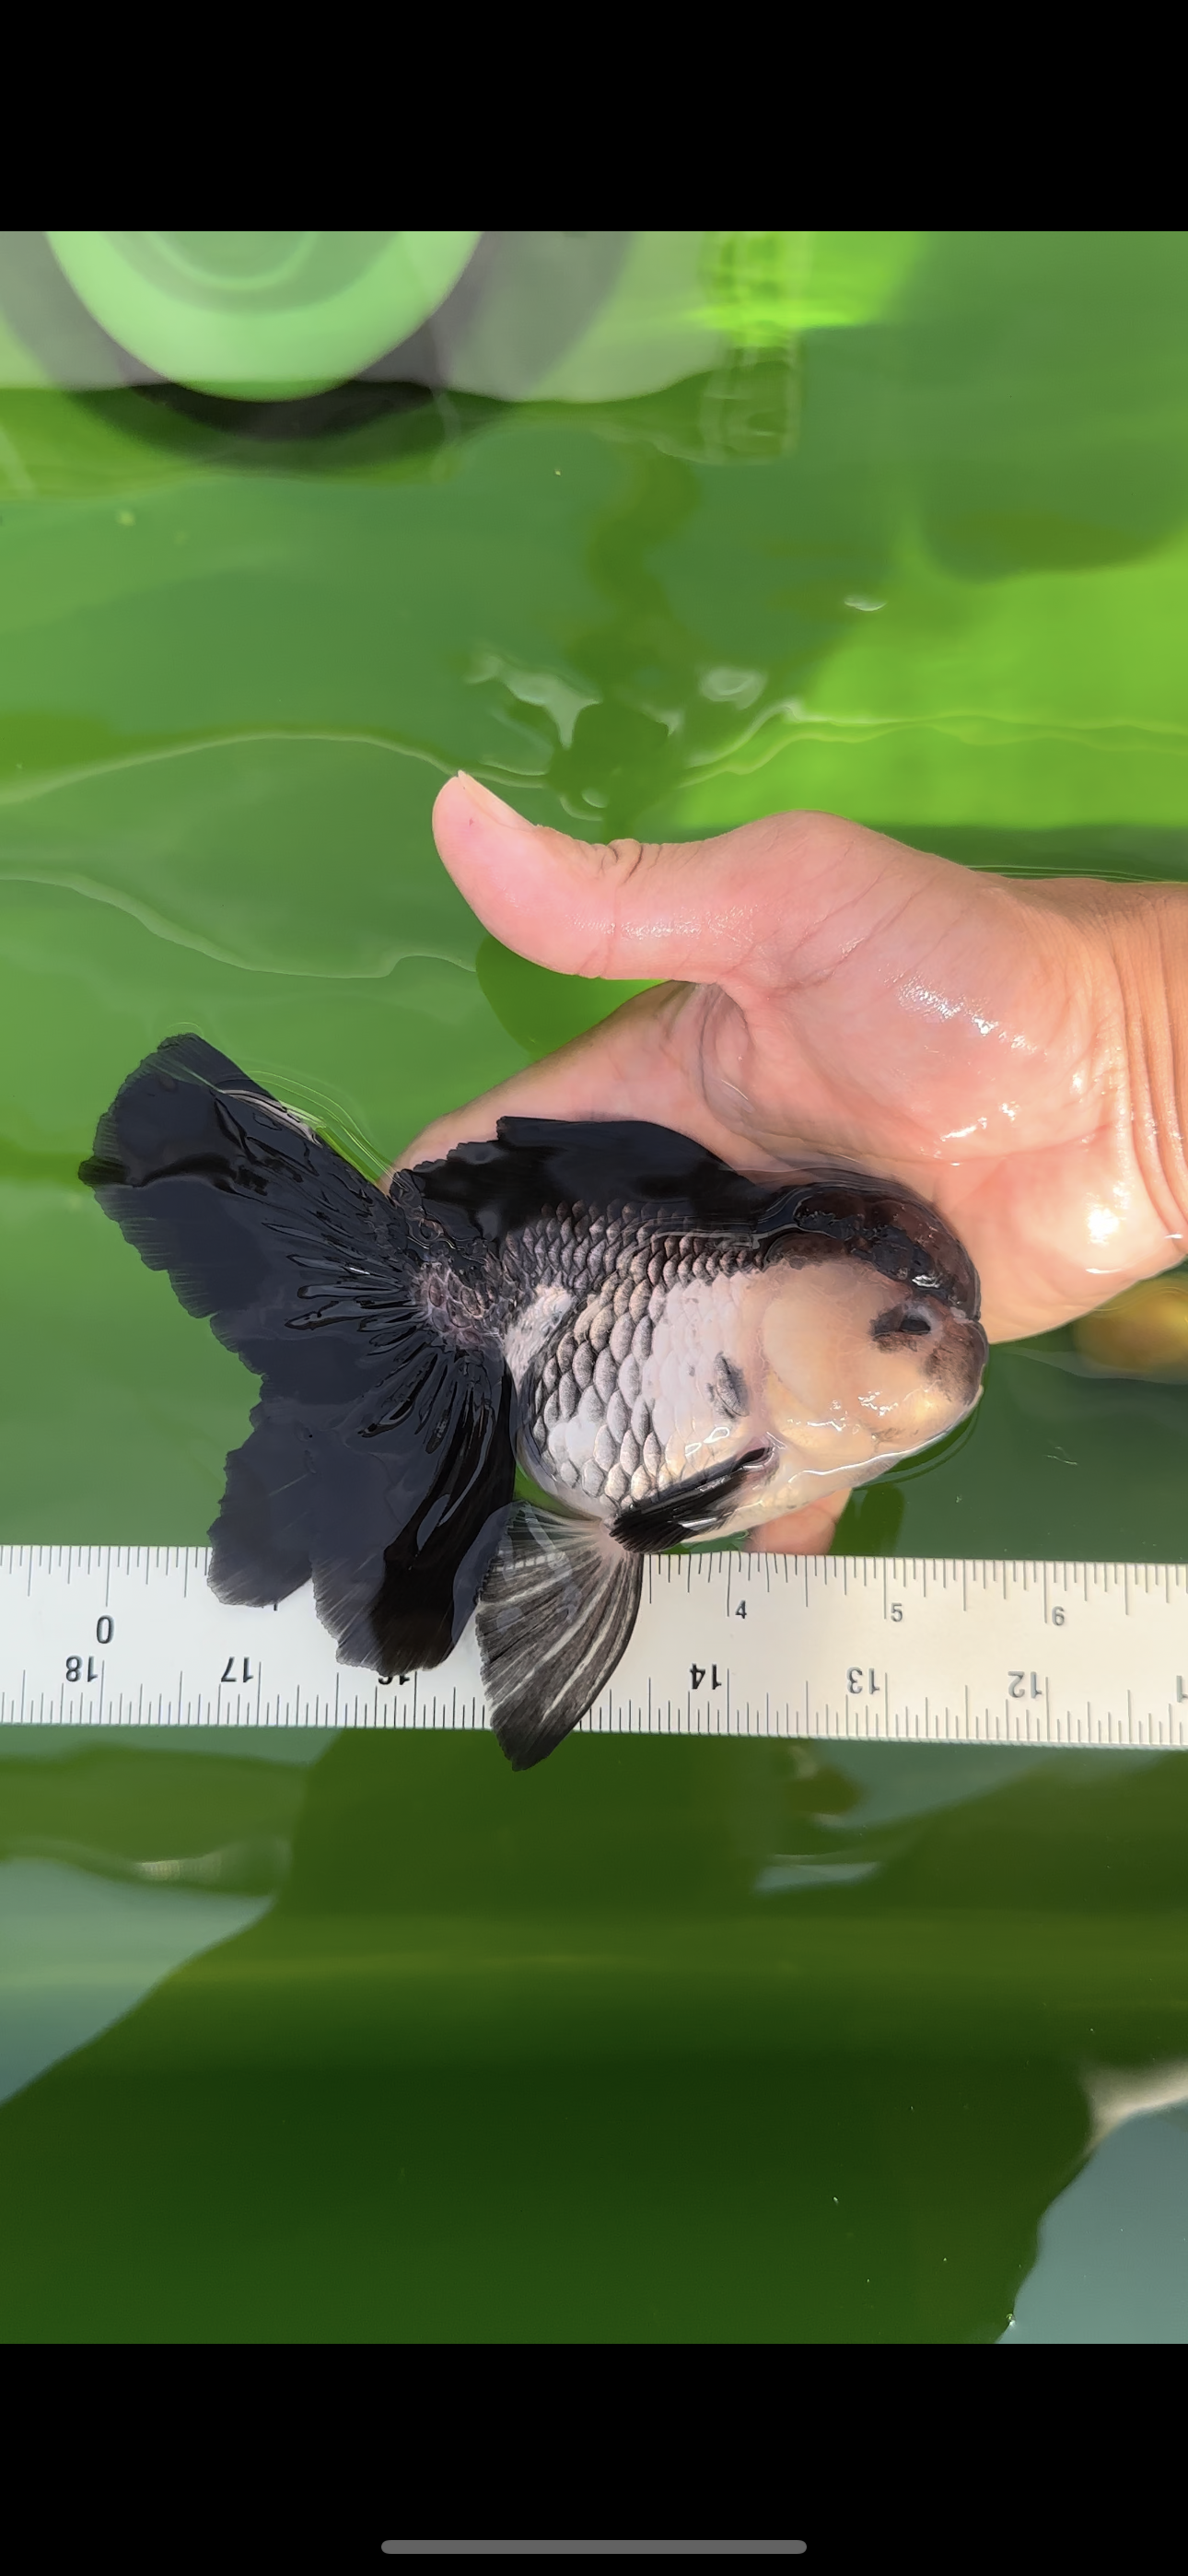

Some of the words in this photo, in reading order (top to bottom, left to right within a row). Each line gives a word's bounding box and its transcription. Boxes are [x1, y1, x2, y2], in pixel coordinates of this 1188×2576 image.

[735, 1599, 748, 1620] 4
[891, 1602, 903, 1622] 5
[1052, 1606, 1066, 1627] 6
[96, 1615, 114, 1645] 0
[65, 1656, 99, 1683] 18
[220, 1656, 254, 1683] 17
[689, 1663, 723, 1691] 14
[845, 1666, 880, 1695] 13
[1007, 1670, 1042, 1699] 12
